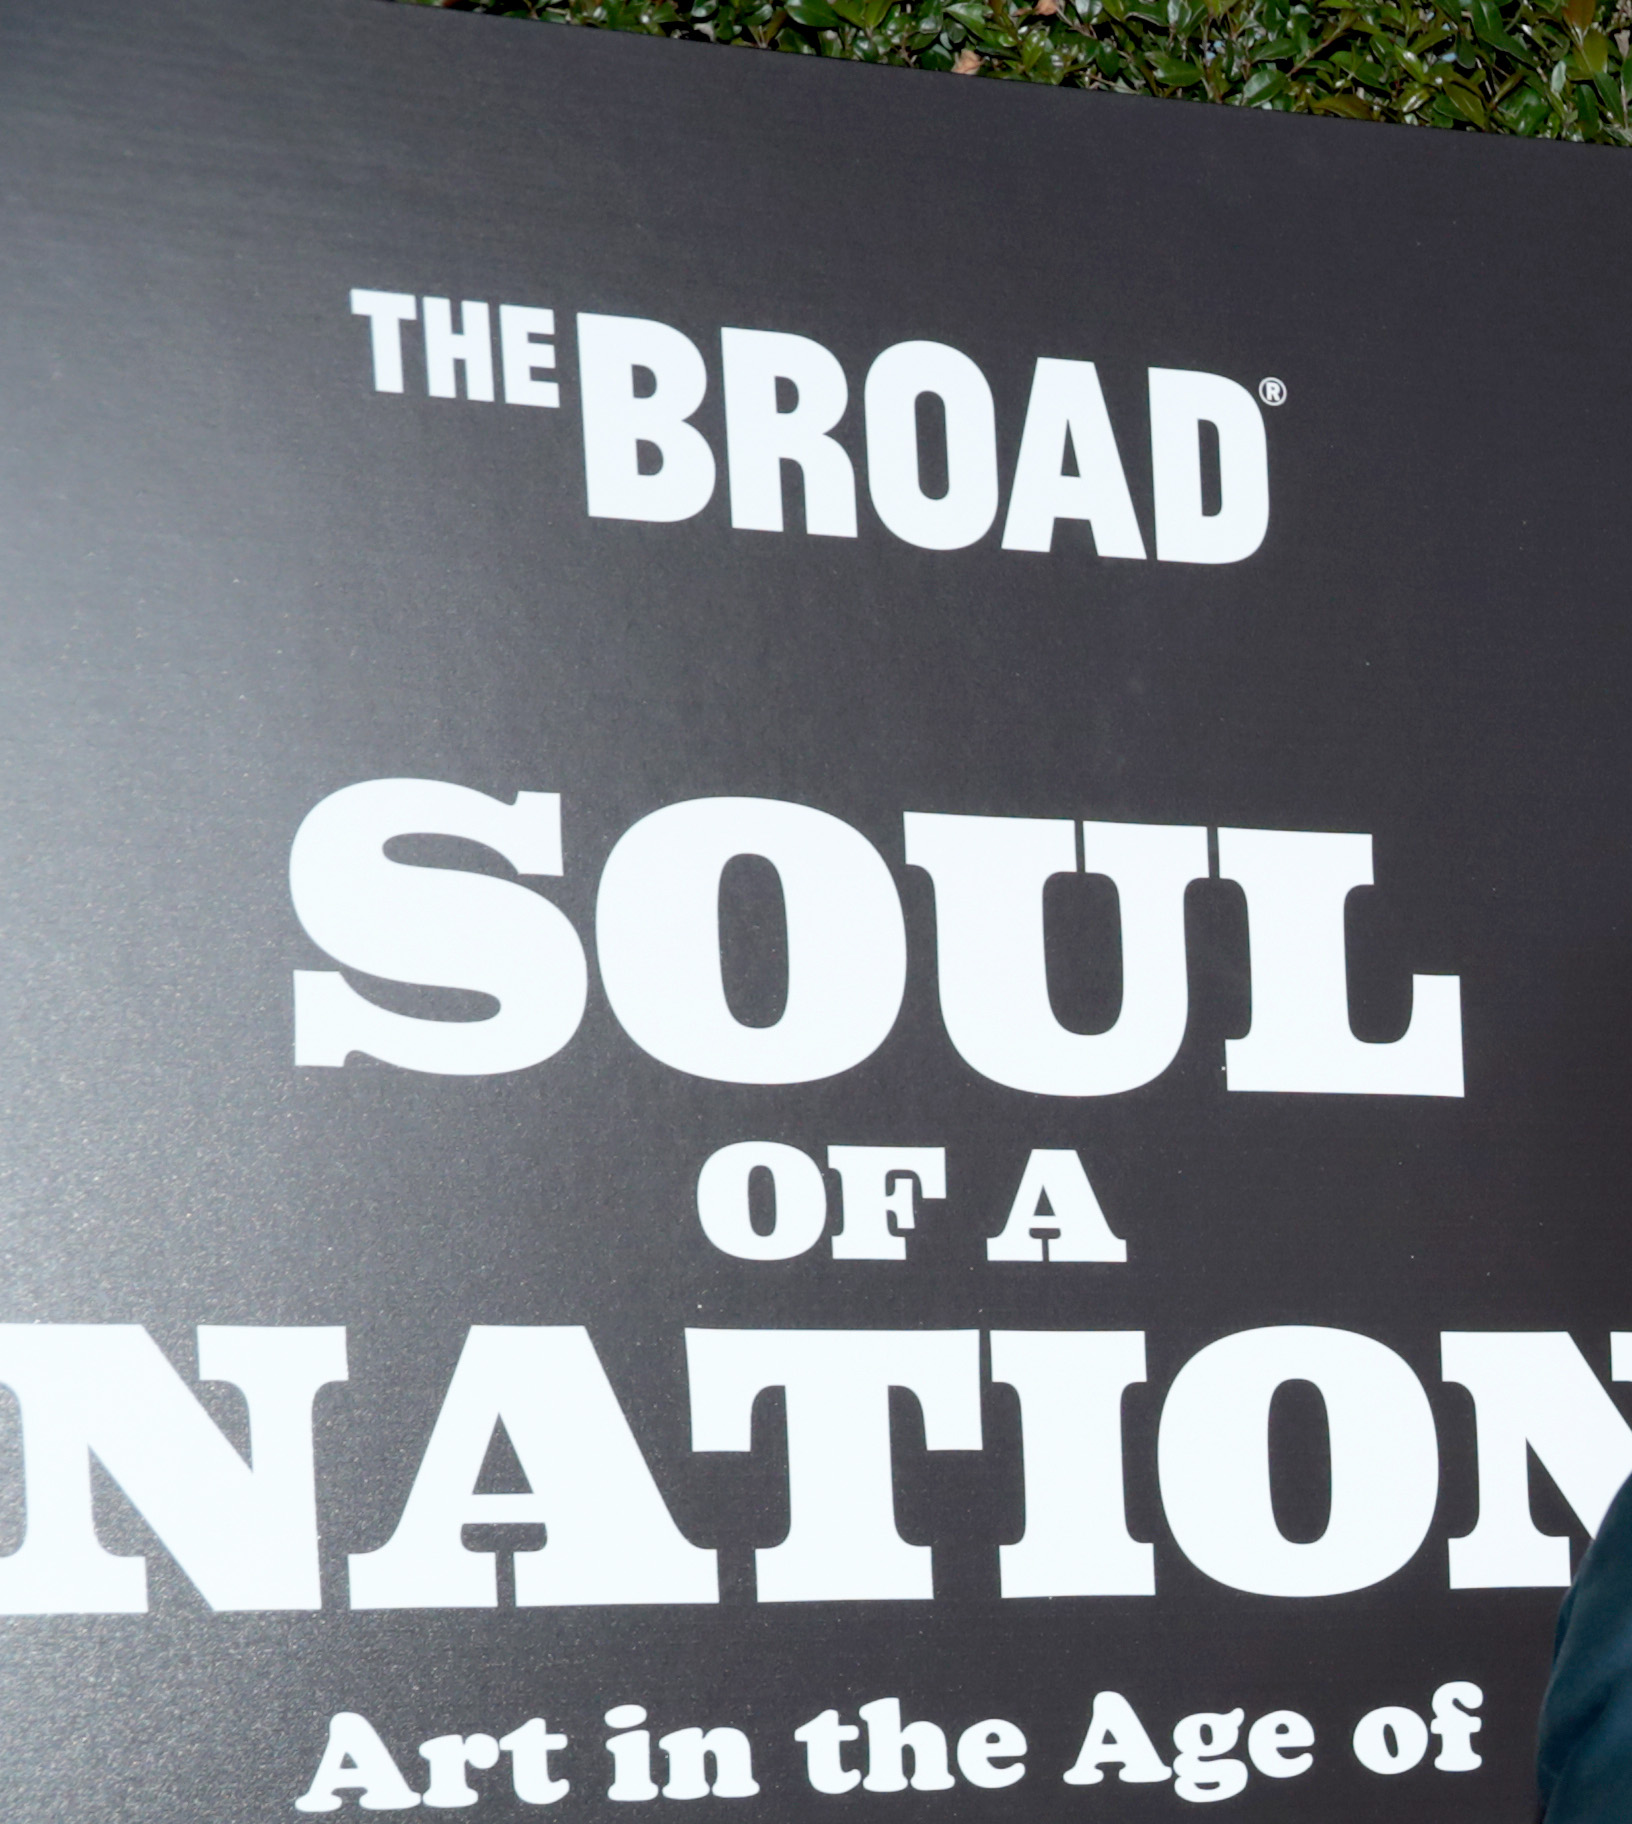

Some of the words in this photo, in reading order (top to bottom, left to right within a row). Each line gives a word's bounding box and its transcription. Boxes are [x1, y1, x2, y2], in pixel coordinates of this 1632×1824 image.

[350, 288, 561, 409] THE
[288, 777, 1465, 1098] SOUL
[697, 1140, 947, 1262] OF
[987, 1148, 1128, 1263] A
[295, 1711, 571, 1814] Art
[605, 1704, 760, 1802] in
[794, 1697, 1028, 1795] the
[1062, 1690, 1315, 1803] Age
[1352, 1681, 1484, 1775] of
